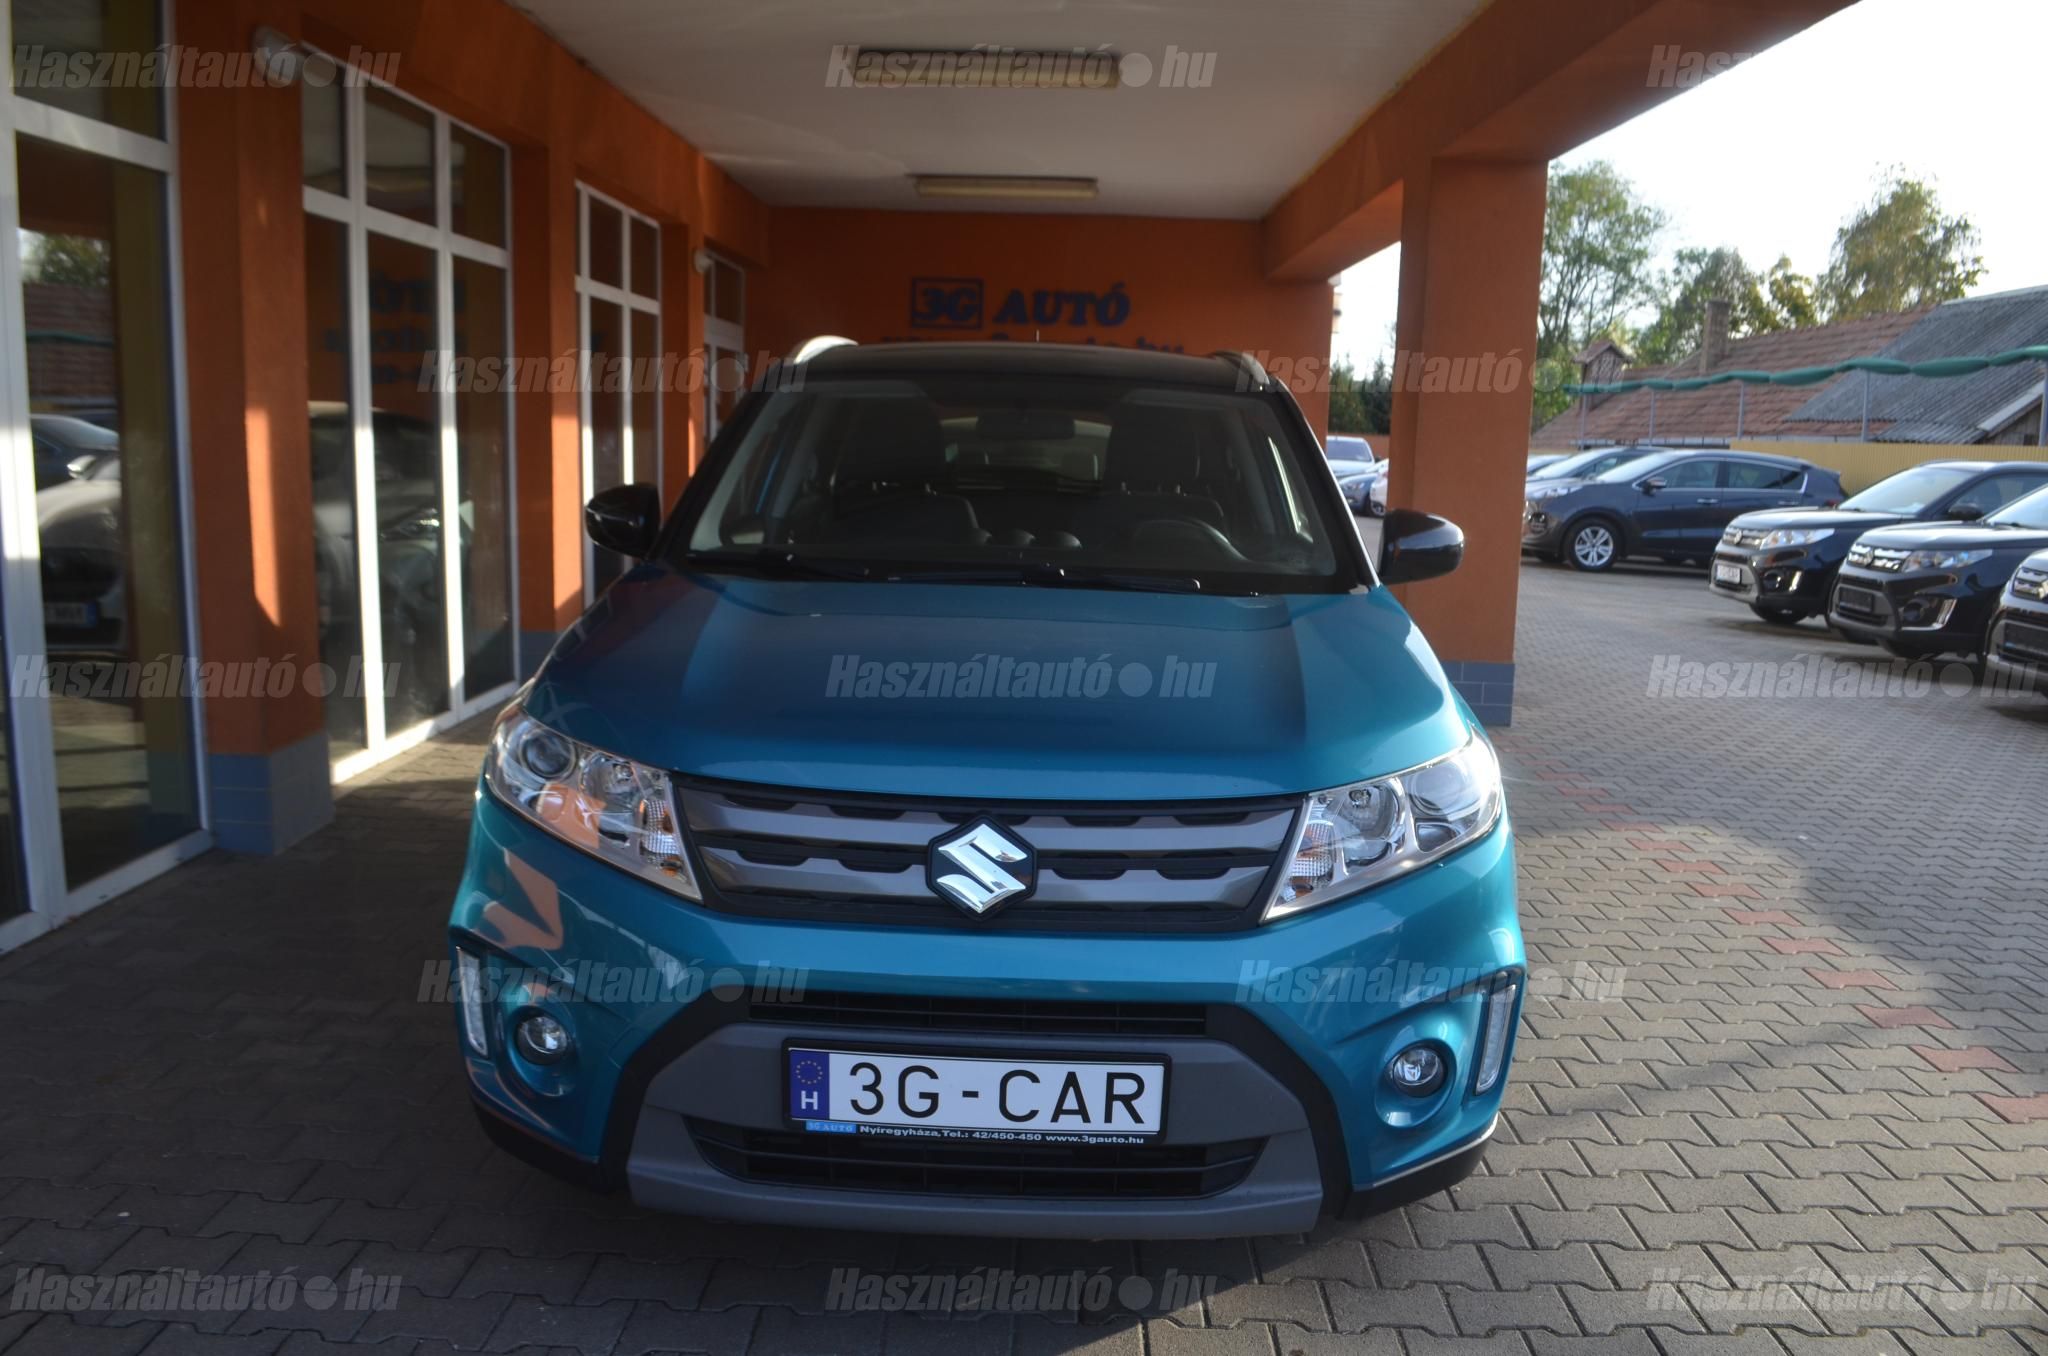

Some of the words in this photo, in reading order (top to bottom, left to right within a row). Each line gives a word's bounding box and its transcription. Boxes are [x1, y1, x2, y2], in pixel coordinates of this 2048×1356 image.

[992, 280, 1132, 327] AUTÓ
[801, 1090, 818, 1110] H
[972, 1131, 1042, 1141] 42/450-450
[1045, 1134, 1145, 1144] www.3gauto.hu
